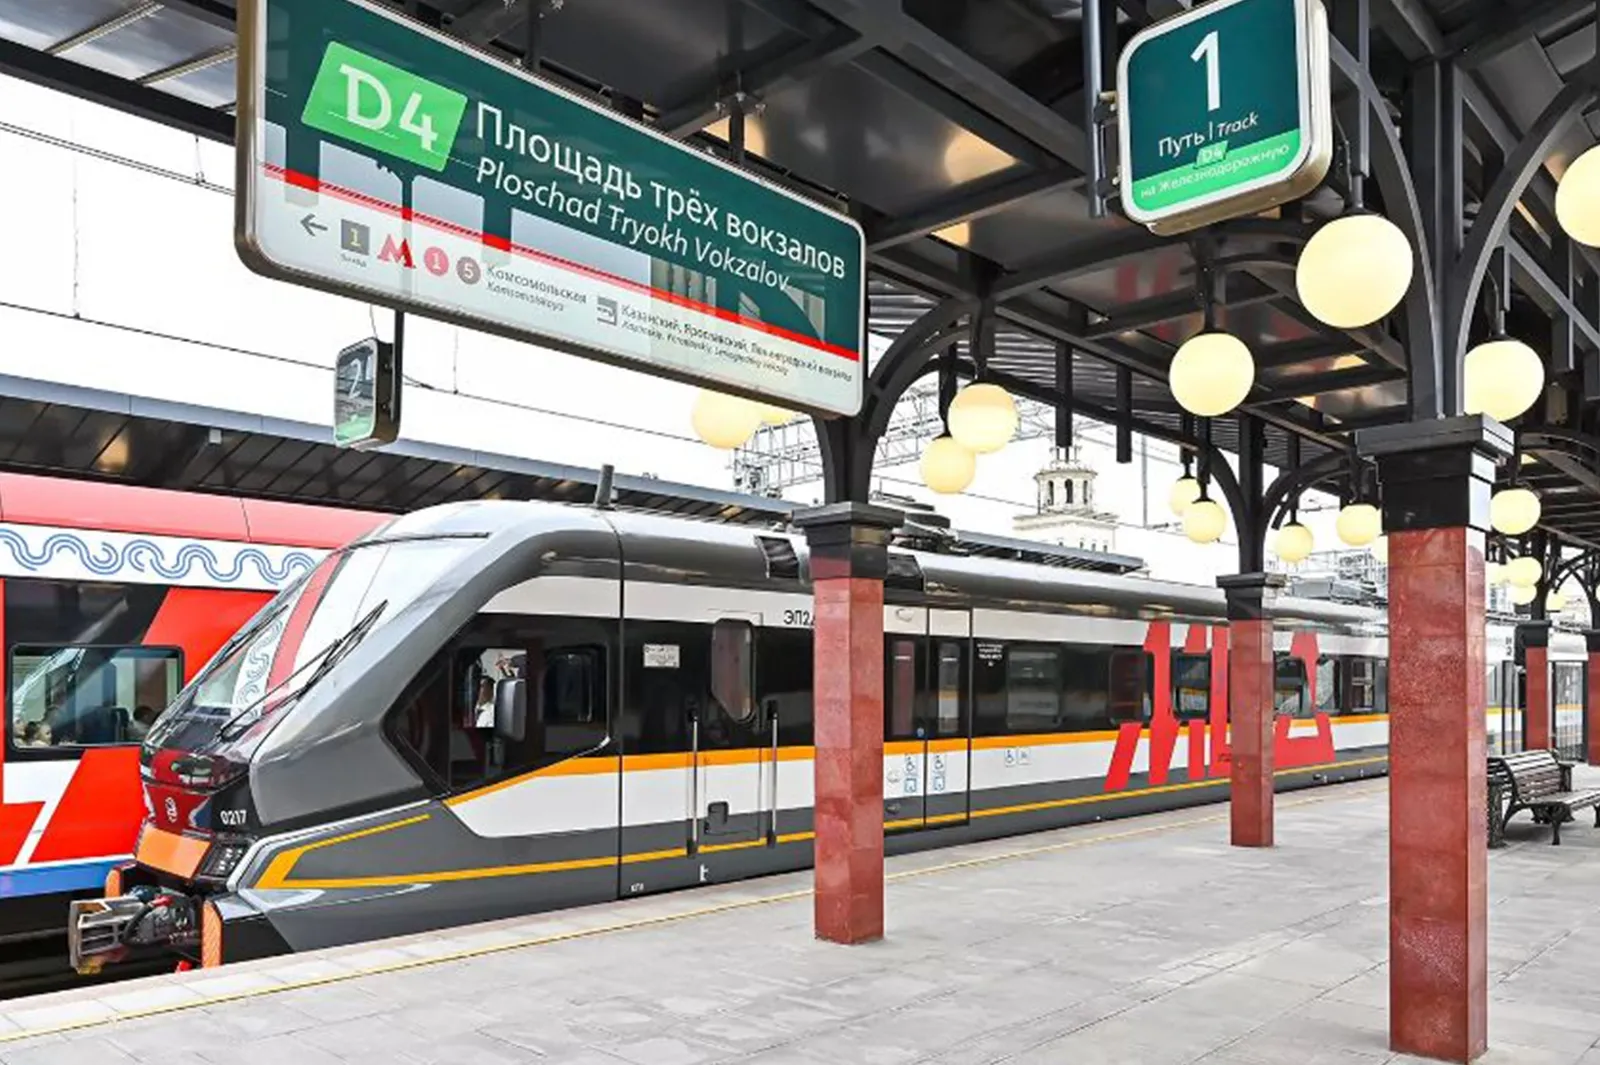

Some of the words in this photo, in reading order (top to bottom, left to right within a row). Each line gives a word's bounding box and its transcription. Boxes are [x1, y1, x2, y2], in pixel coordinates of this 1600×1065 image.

[1190, 30, 1220, 111] 1
[339, 63, 438, 153] D4
[1216, 111, 1259, 138] Track
[1158, 132, 1205, 158] Путь
[477, 101, 642, 200] Площадь
[650, 181, 718, 231] трёх
[726, 212, 845, 280] вокзалов
[476, 157, 602, 224] Ploschad
[608, 205, 688, 256] Tryokh
[695, 236, 790, 291] Vokzalov
[783, 610, 815, 626] ЭП2
[220, 809, 247, 825] 0217
